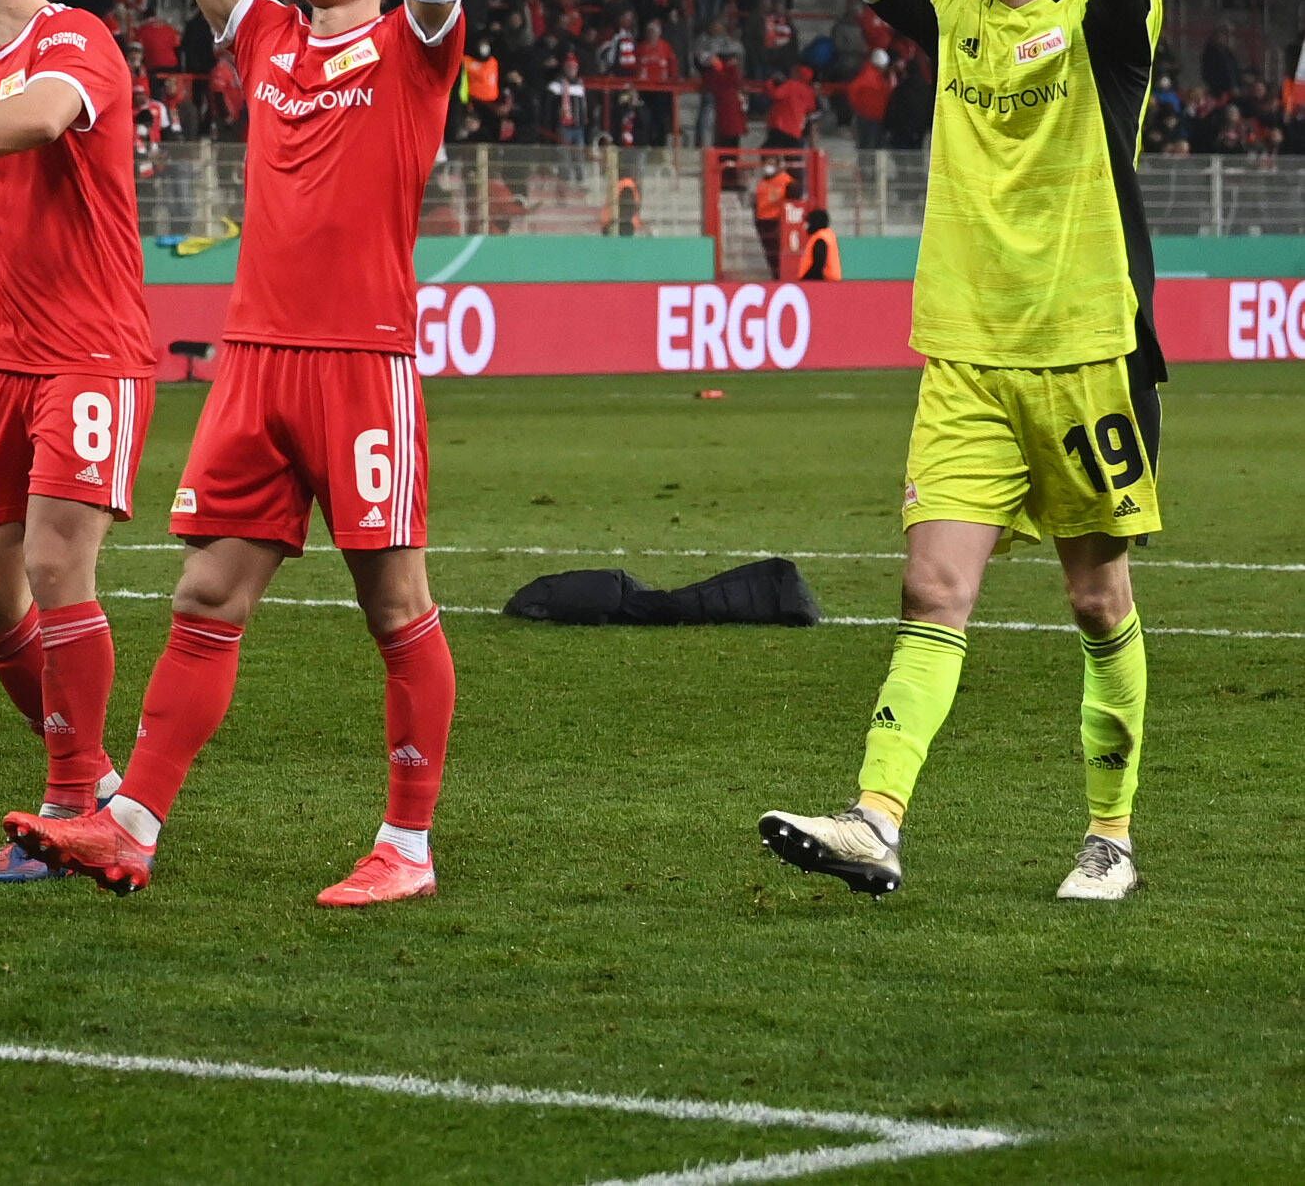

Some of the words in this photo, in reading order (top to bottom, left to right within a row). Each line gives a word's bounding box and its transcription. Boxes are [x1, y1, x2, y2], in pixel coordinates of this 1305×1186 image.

[945, 77, 1069, 114] AOUDTOWN
[414, 285, 496, 376] GO
[656, 283, 811, 372] ERGO
[1228, 280, 1305, 359] ERG
[72, 391, 113, 463] 8
[1062, 413, 1146, 494] 19
[353, 428, 392, 504] 6
[1113, 505, 1141, 518] adidas
